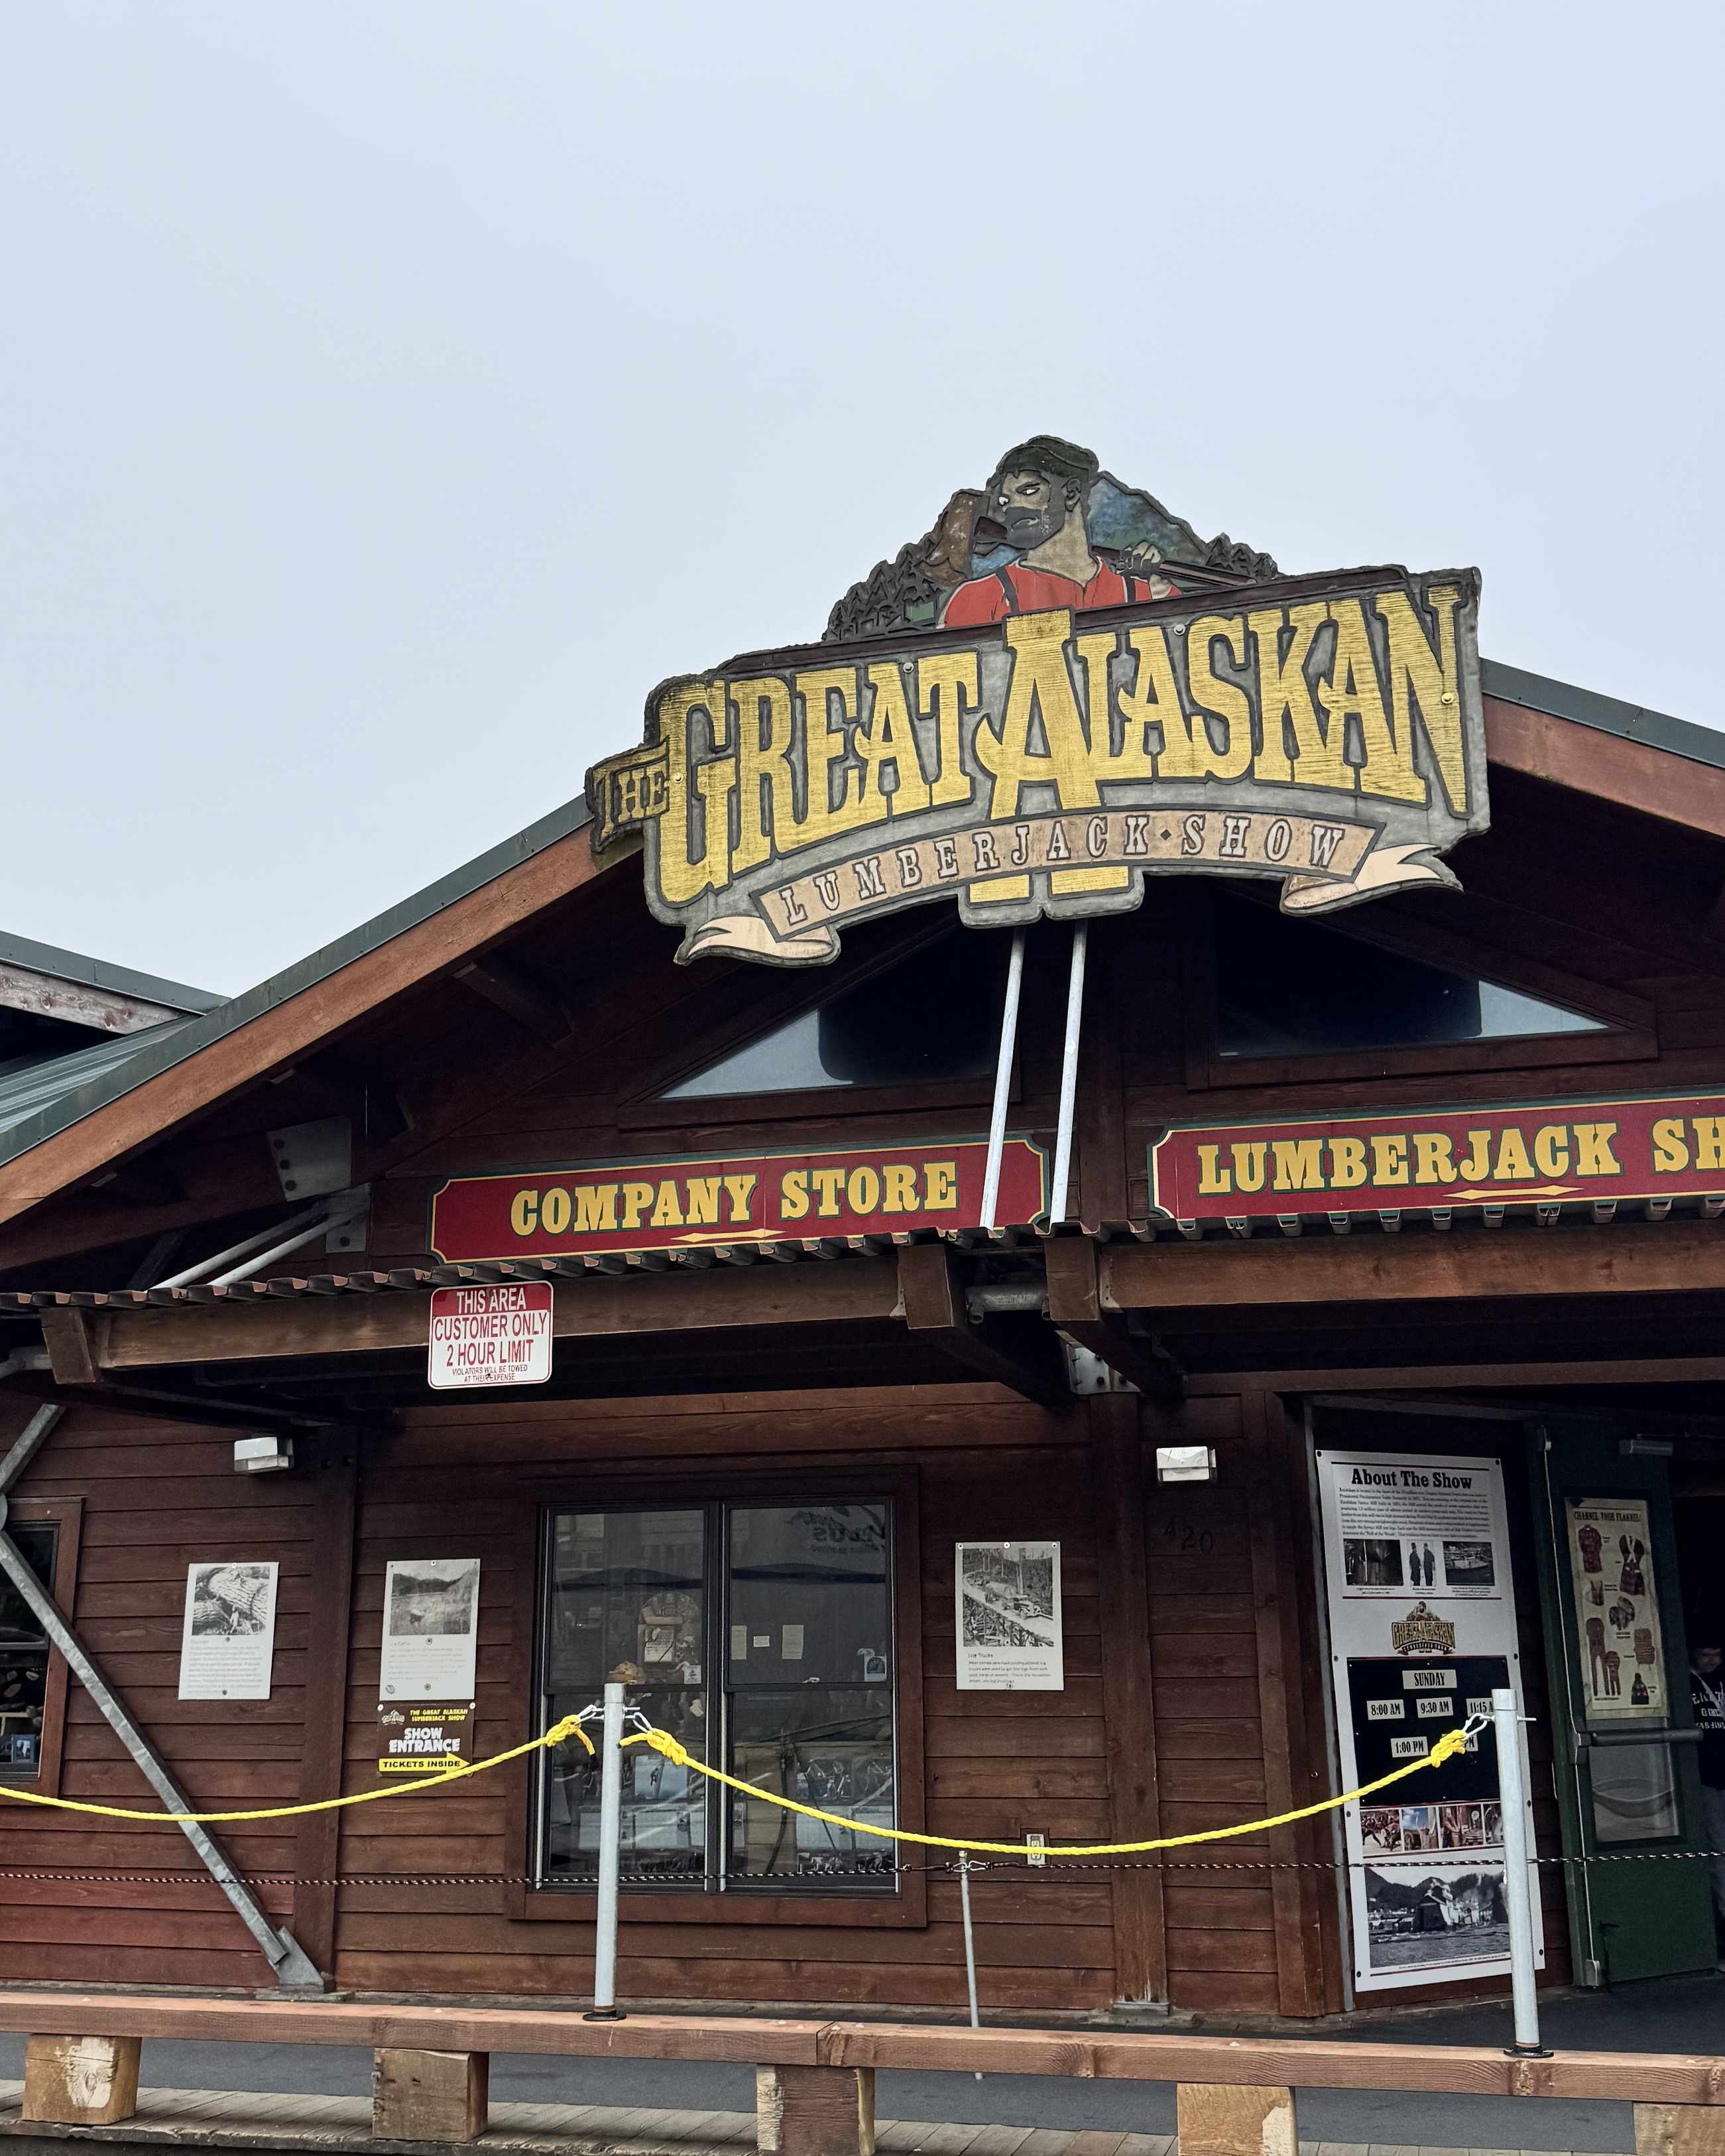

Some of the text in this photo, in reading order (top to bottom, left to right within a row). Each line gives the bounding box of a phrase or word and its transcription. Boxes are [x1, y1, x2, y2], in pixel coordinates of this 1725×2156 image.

[659, 585, 1467, 904] GREAT ALASKAN
[595, 741, 670, 841] THE
[780, 814, 1345, 926] LUMBERJACK SHOW
[1197, 1122, 1622, 1195] LUMBERJACK
[510, 1160, 958, 1236] COMPANY STORE
[456, 1288, 526, 1314] THIS AREA
[434, 1312, 548, 1341] CUSTOMER ONLY
[446, 1339, 534, 1367] 2 HOUR LIMIT
[452, 1367, 483, 1376] VIOLATORS
[508, 1364, 528, 1372] TOWED
[1352, 1468, 1472, 1490] About The Show
[1413, 1672, 1445, 1687] SUNDAY
[1370, 1703, 1401, 1716] 8:00 AM
[1420, 1701, 1449, 1714] 9:30 AM
[1470, 1701, 1488, 1714] 11:15
[404, 1727, 443, 1740] SHOW
[388, 1738, 461, 1754] ENTRANCE
[1396, 1740, 1424, 1754] 1:00 PM
